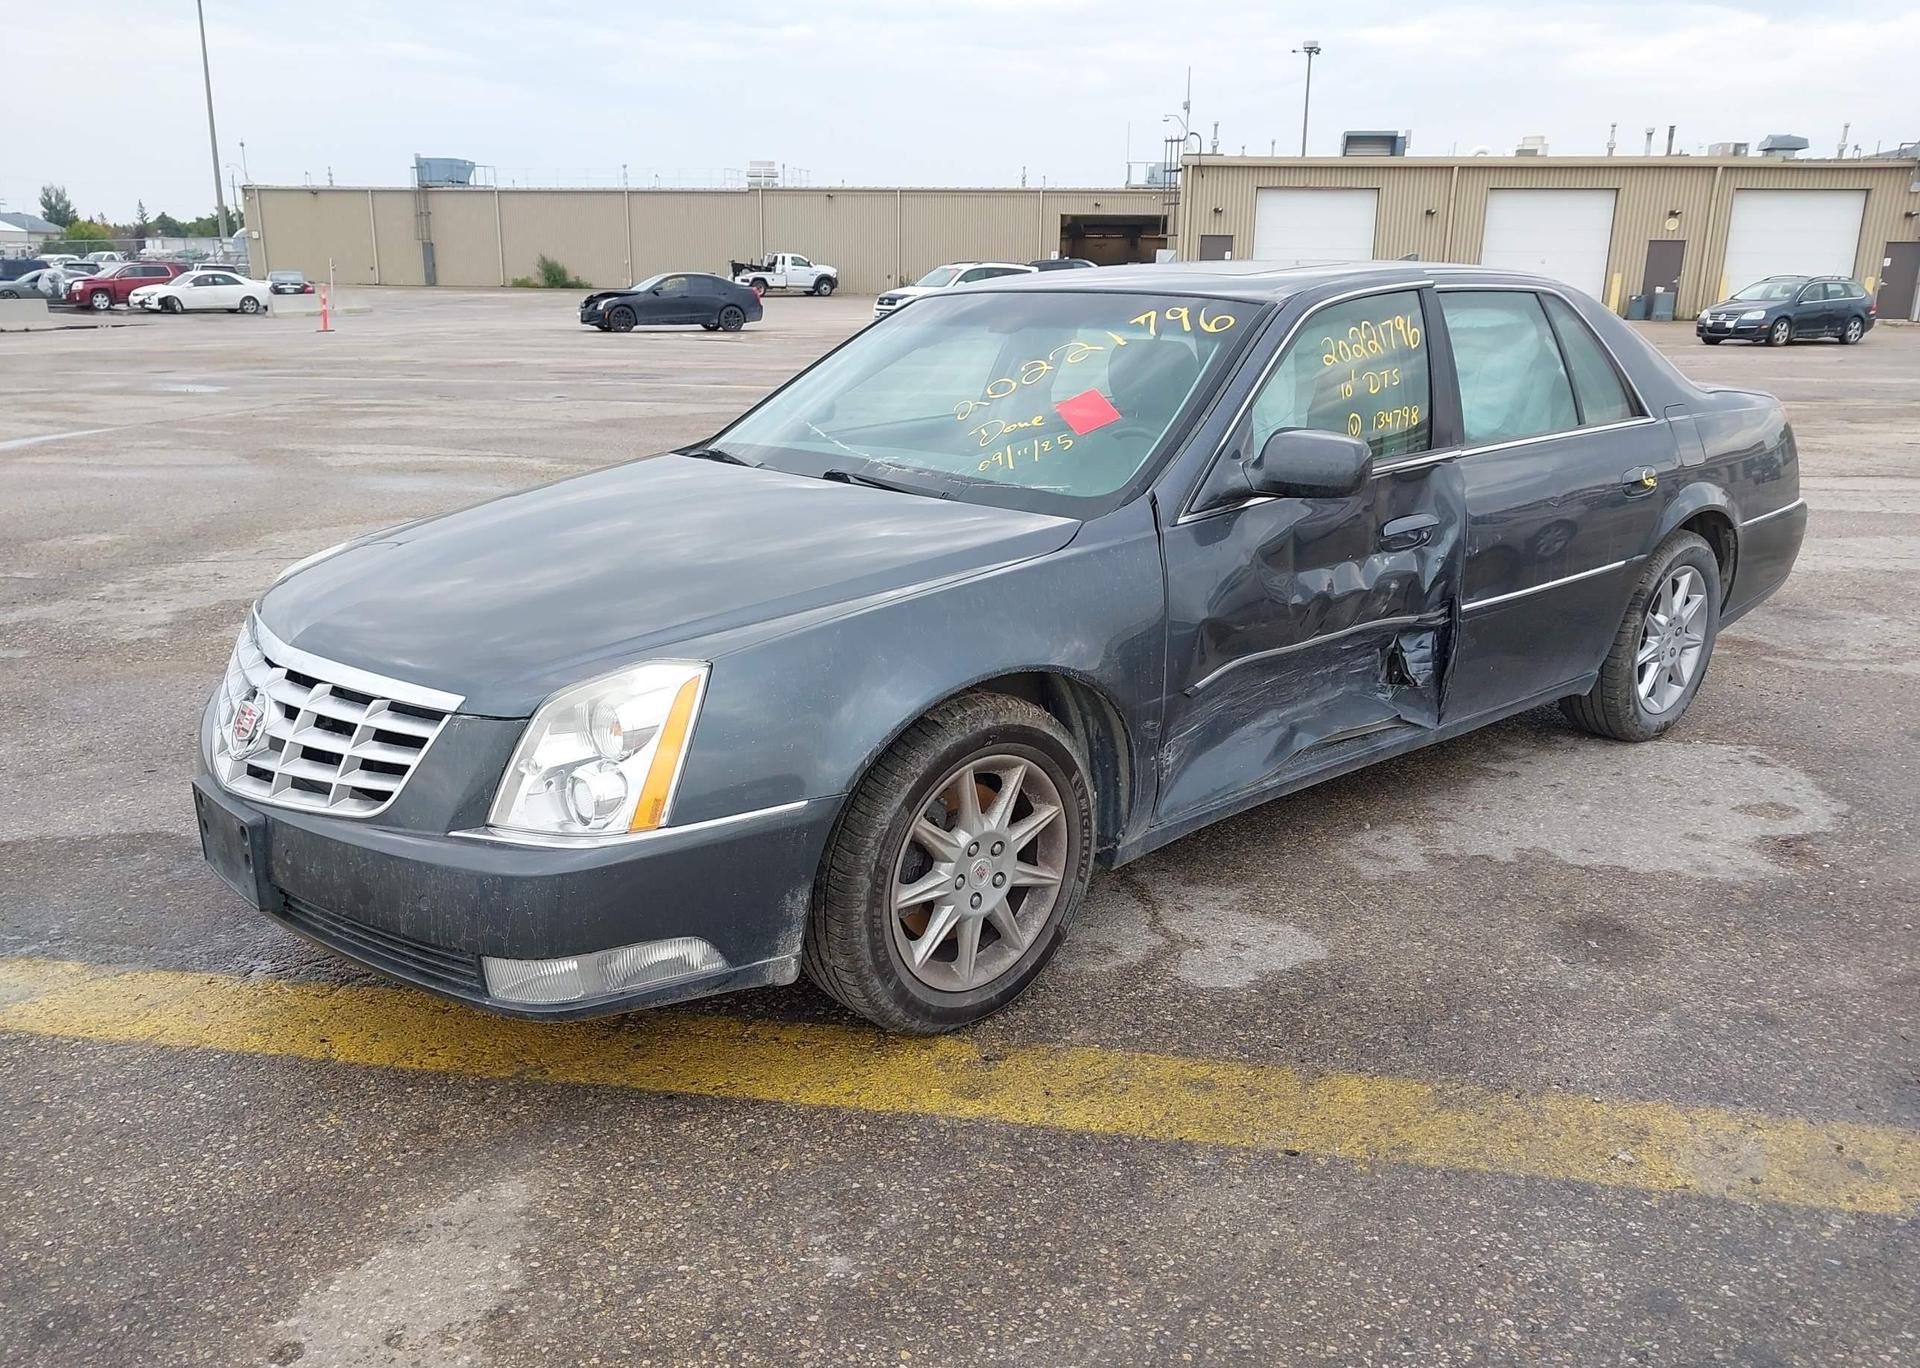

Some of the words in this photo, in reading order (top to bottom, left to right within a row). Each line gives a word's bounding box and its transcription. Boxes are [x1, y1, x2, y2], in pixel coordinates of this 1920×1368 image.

[1320, 315, 1421, 366] 20221796
[1362, 368, 1400, 394] DTS
[1373, 405, 1419, 432] 134798
